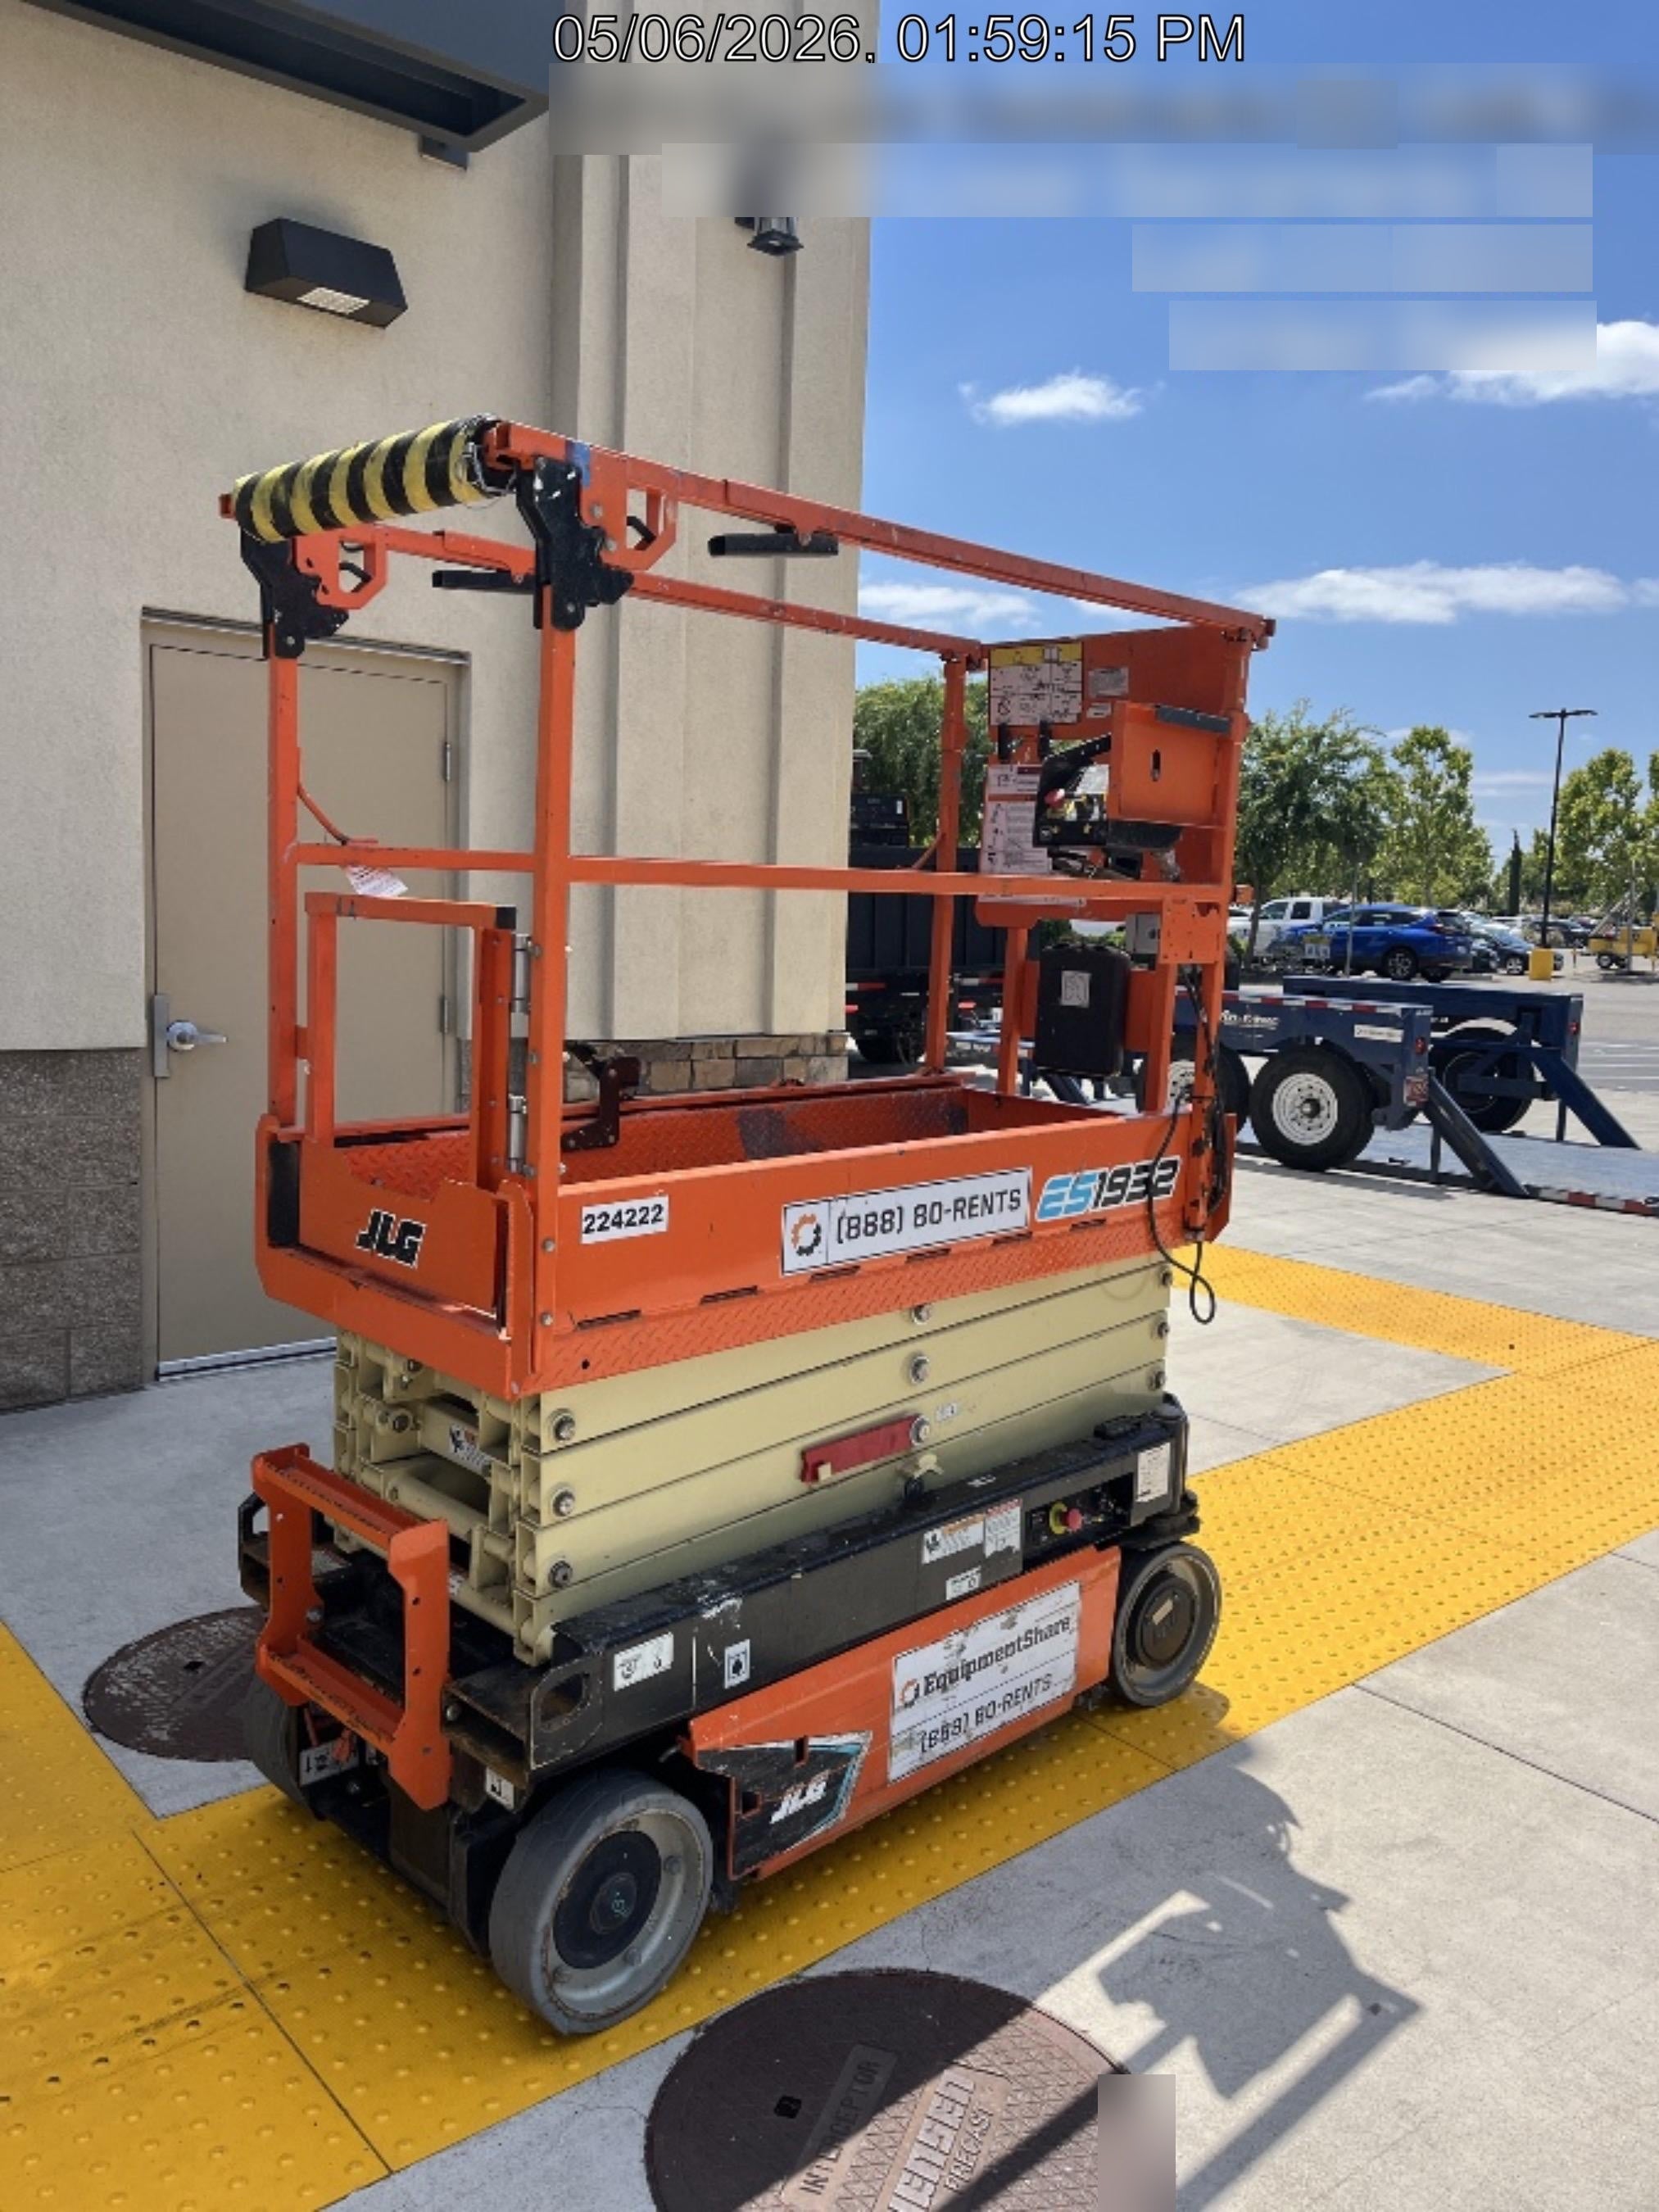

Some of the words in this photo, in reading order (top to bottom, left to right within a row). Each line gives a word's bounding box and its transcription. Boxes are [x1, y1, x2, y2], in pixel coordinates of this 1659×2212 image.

[582, 1203, 664, 1235] 224222
[837, 1206, 903, 1244] (888)
[913, 1188, 1022, 1228] 80-RENTS
[1036, 1155, 1181, 1222] ES1932
[355, 1208, 427, 1268] JLG
[923, 1616, 1071, 1695] EquipmentShare
[799, 2060, 882, 2196] INTERCEPTOR
[943, 2108, 994, 2195] PRECAST
